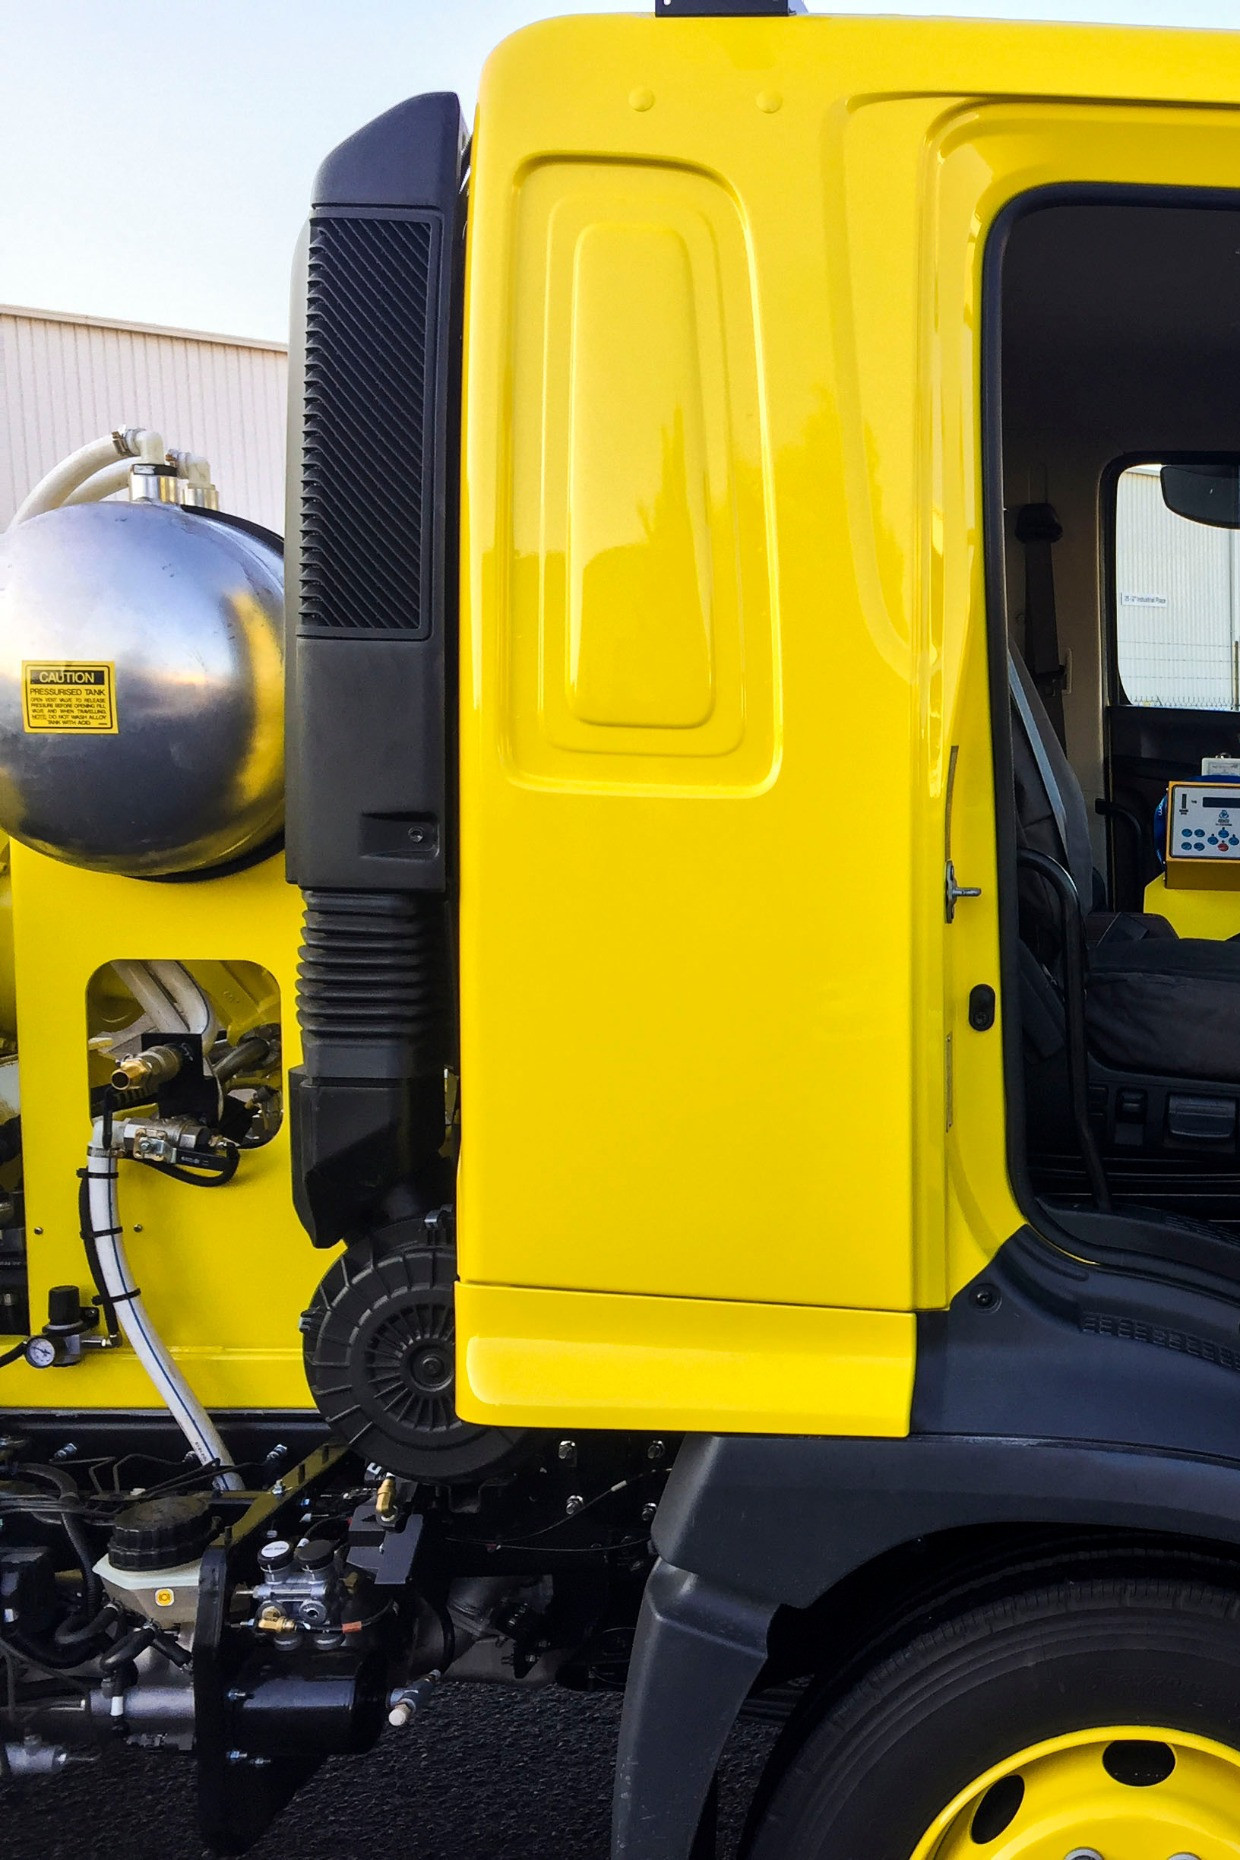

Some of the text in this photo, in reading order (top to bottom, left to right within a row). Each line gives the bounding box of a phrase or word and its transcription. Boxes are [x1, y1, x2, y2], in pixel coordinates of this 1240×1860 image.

[39, 670, 95, 684] CAUTION
[30, 688, 106, 696] PRESSURISED TANK
